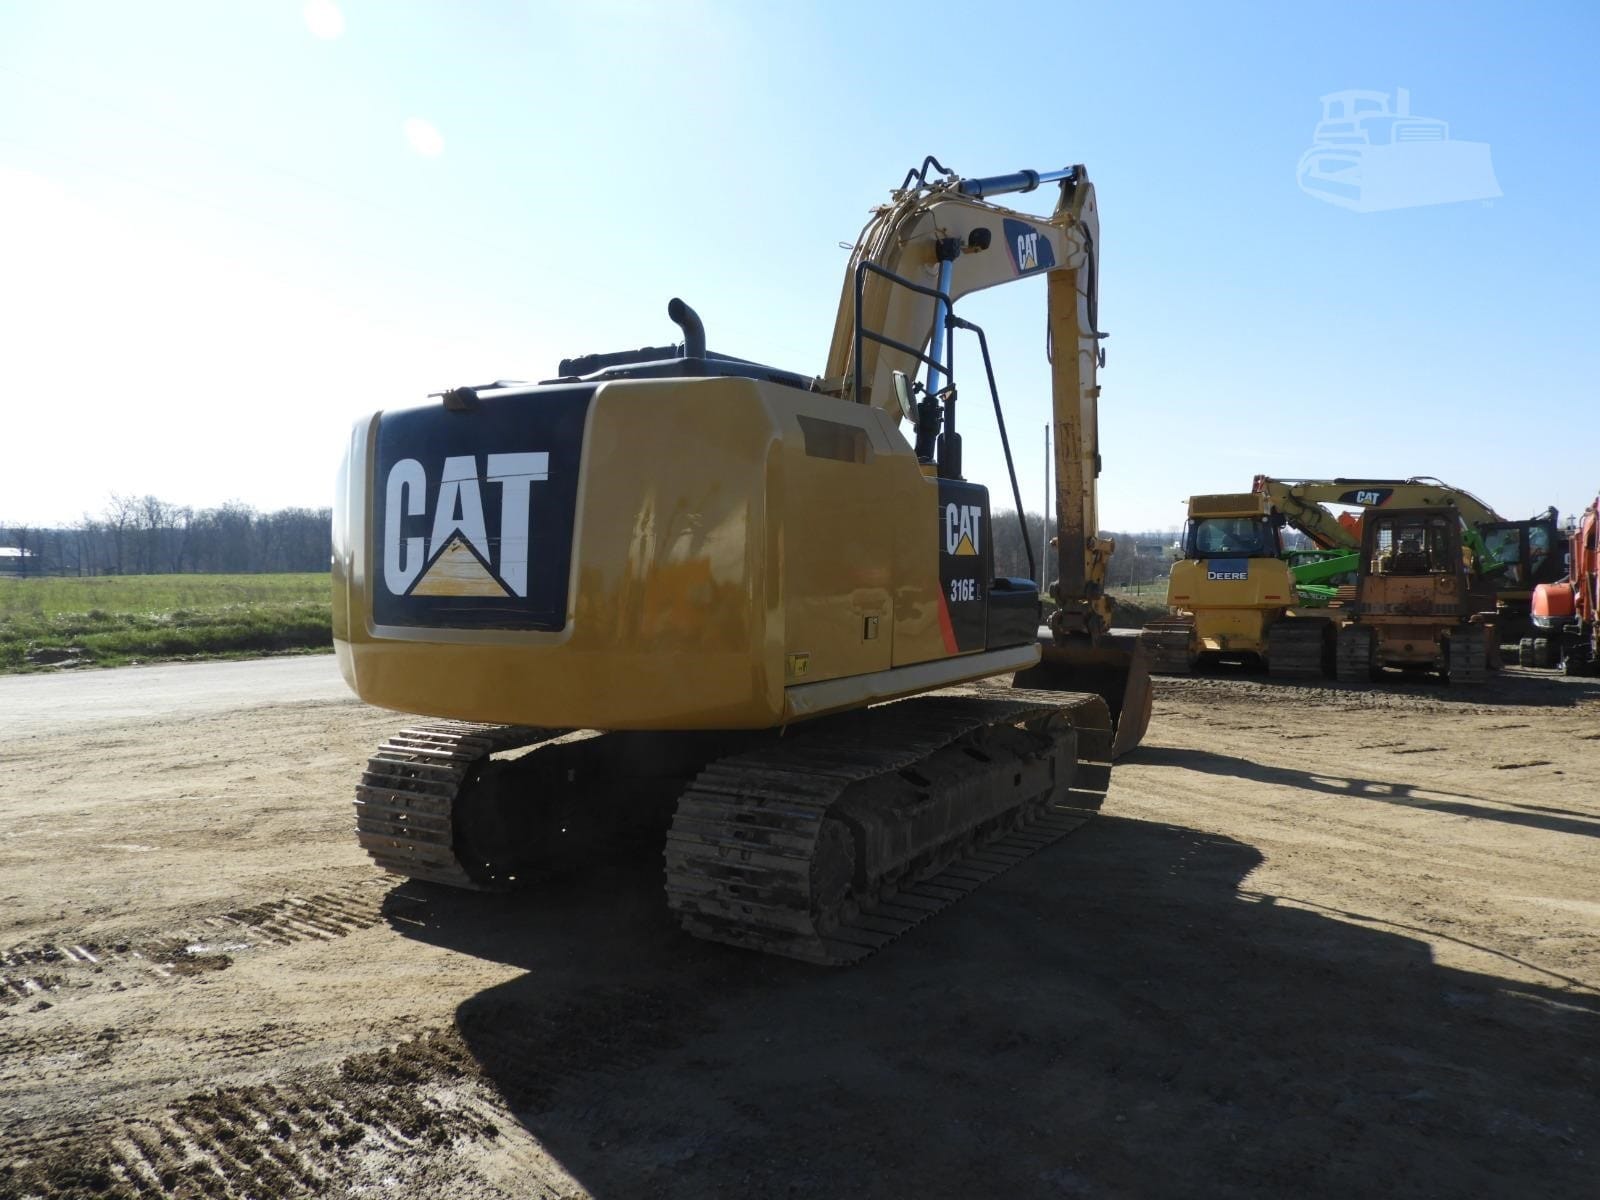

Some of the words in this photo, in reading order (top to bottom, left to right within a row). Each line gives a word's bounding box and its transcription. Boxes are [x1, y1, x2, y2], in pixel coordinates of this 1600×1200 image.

[1017, 233, 1038, 270] CAT
[1356, 490, 1380, 505] CAT
[384, 451, 550, 598] CAT
[946, 502, 981, 555] CAT
[950, 578, 975, 602] 316E
[1207, 571, 1248, 580] DEERE
